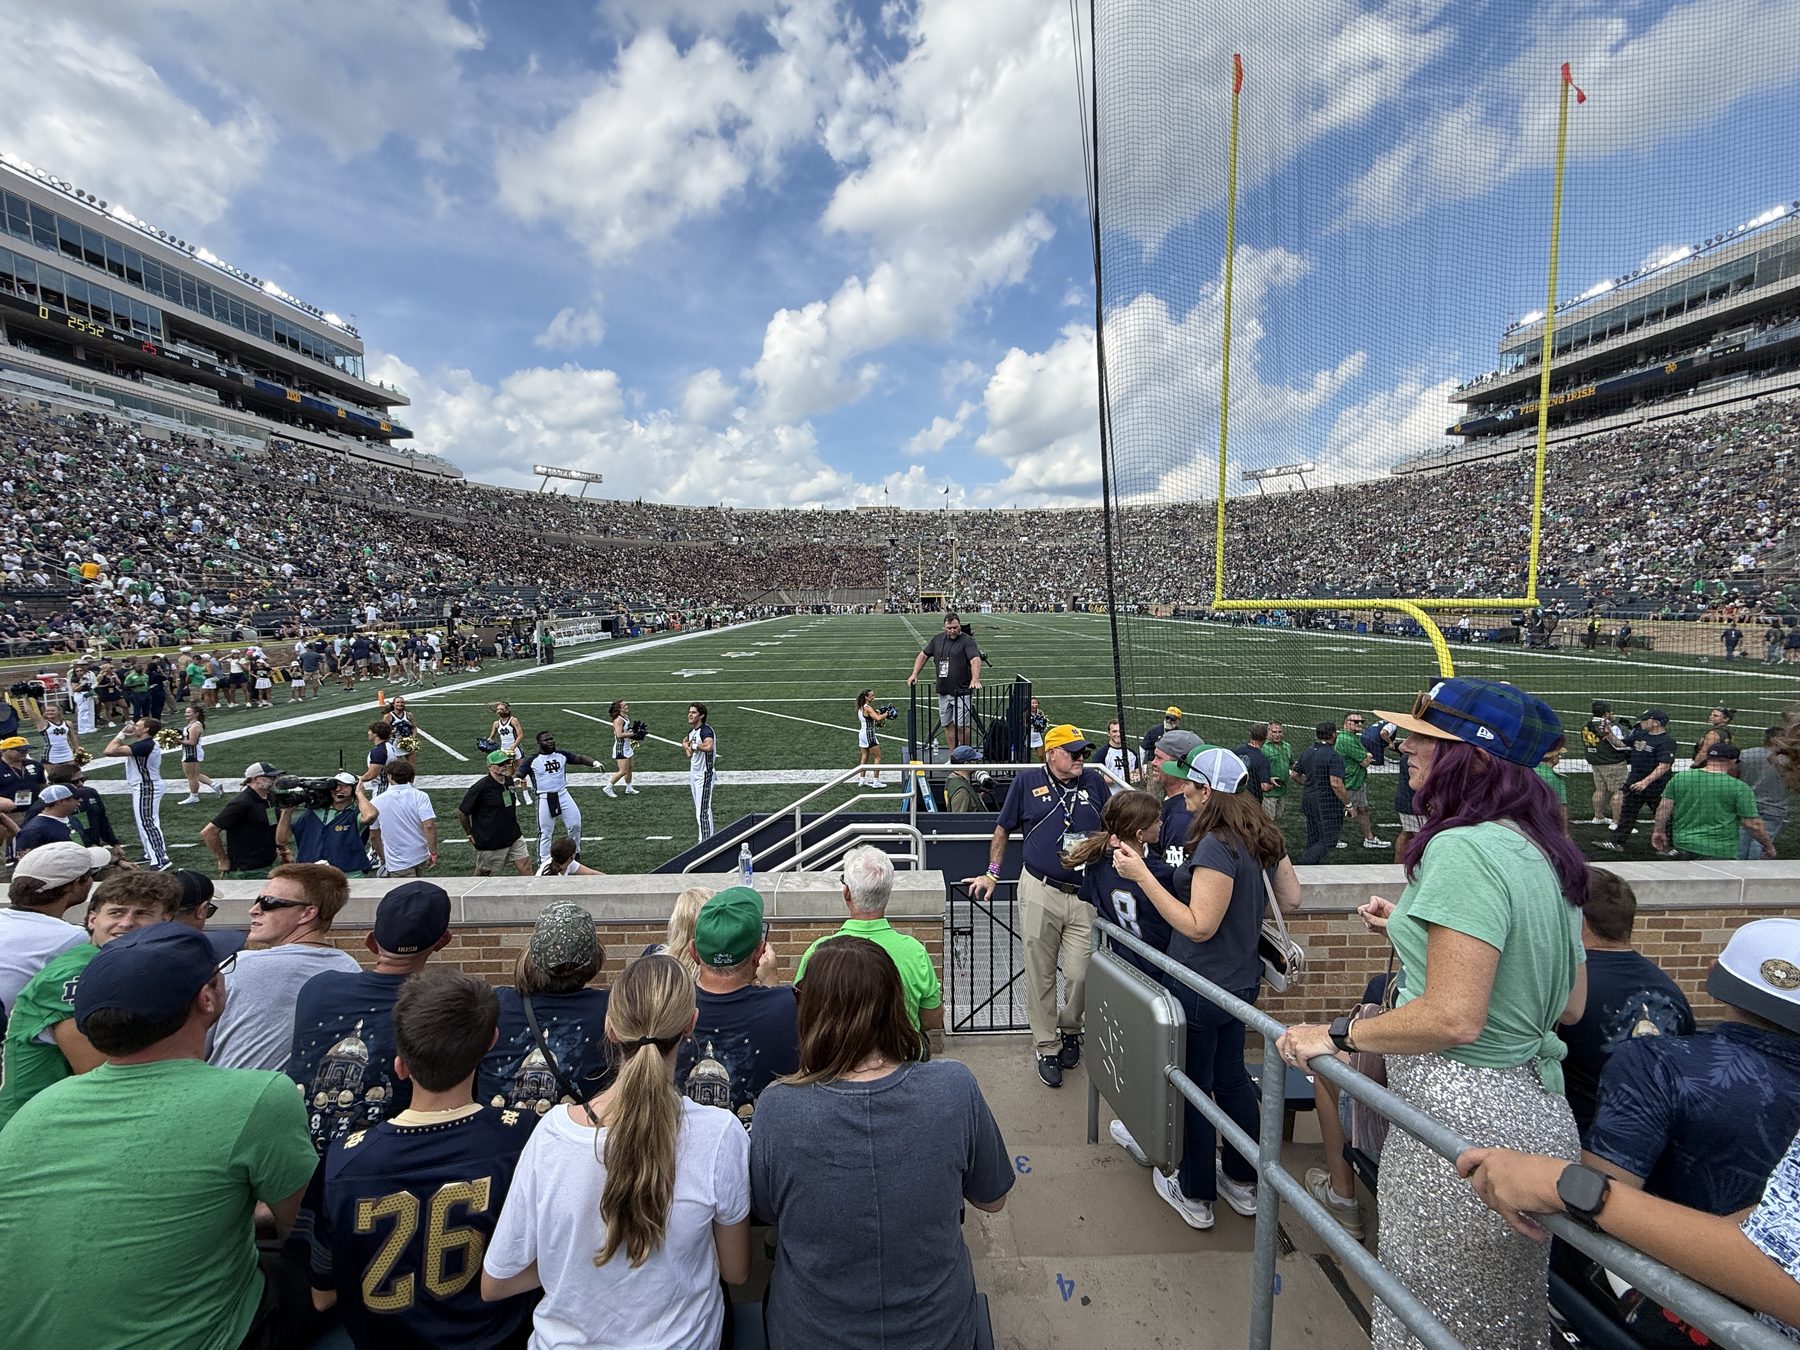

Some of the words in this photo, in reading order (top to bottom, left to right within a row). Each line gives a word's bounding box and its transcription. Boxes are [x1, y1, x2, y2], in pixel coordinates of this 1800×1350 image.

[68, 316, 104, 337] 25:52
[142, 340, 157, 357] 25
[1519, 394, 1565, 416] FIGHING
[1565, 386, 1597, 403] IRISH
[397, 945, 418, 953] IRISH
[1014, 1155, 1032, 1174] 3
[354, 1176, 492, 1314] 26
[1056, 1272, 1075, 1302] 4
